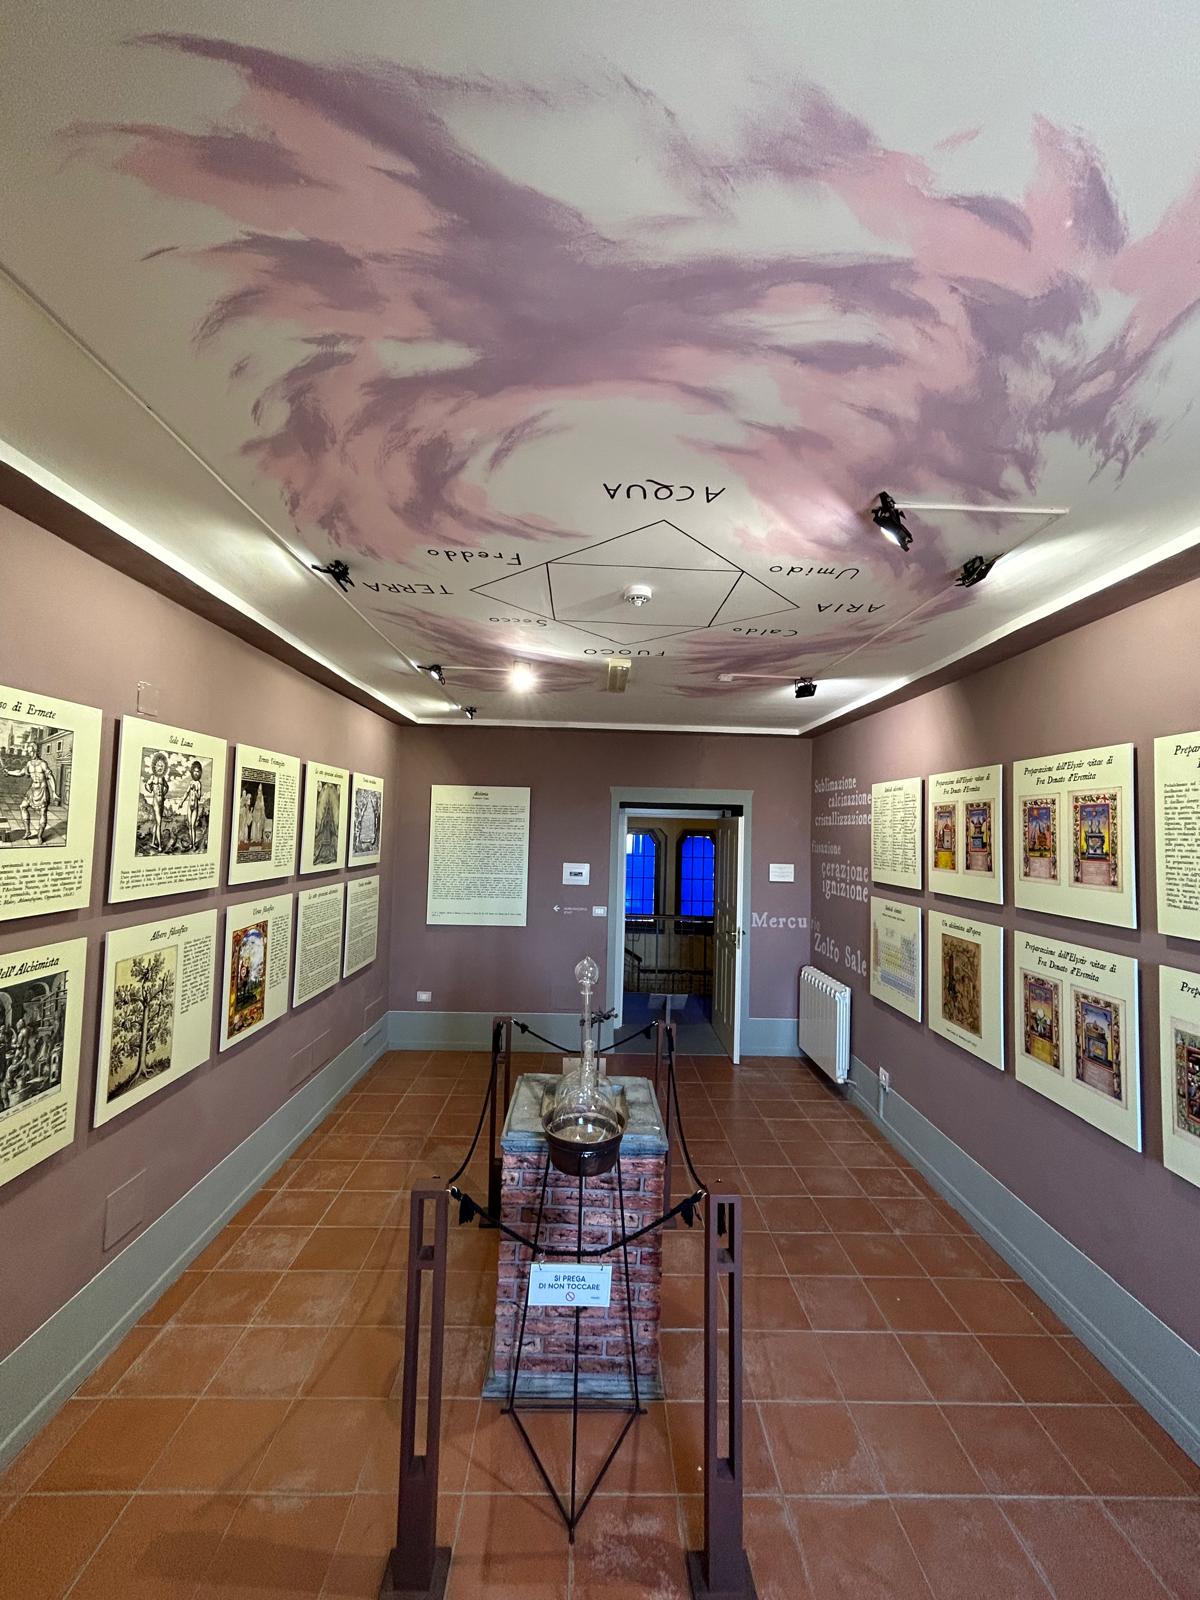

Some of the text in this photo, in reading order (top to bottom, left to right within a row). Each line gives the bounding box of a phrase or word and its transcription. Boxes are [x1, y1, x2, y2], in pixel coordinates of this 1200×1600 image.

[603, 479, 726, 503] ACQUA
[427, 549, 522, 566] Freddo
[769, 564, 860, 581] Umido
[362, 583, 454, 595] TERRA
[817, 602, 886, 614] ARIA
[489, 616, 548, 627] Secco
[732, 626, 799, 638] Caldo
[584, 647, 666, 657] FUOCO
[12, 701, 23, 713] di
[27, 703, 57, 719] Ermete
[1024, 764, 1053, 777] Preparazione
[1106, 755, 1114, 765] di
[814, 776, 857, 793] Sublimazione
[1047, 775, 1066, 785] Donato
[828, 790, 872, 808] calcinazione
[814, 932, 840, 963] Zolfo
[845, 945, 868, 977] Sale
[1024, 941, 1056, 957] Preparazione
[1109, 963, 1117, 973] di
[1049, 960, 1068, 973] Donato
